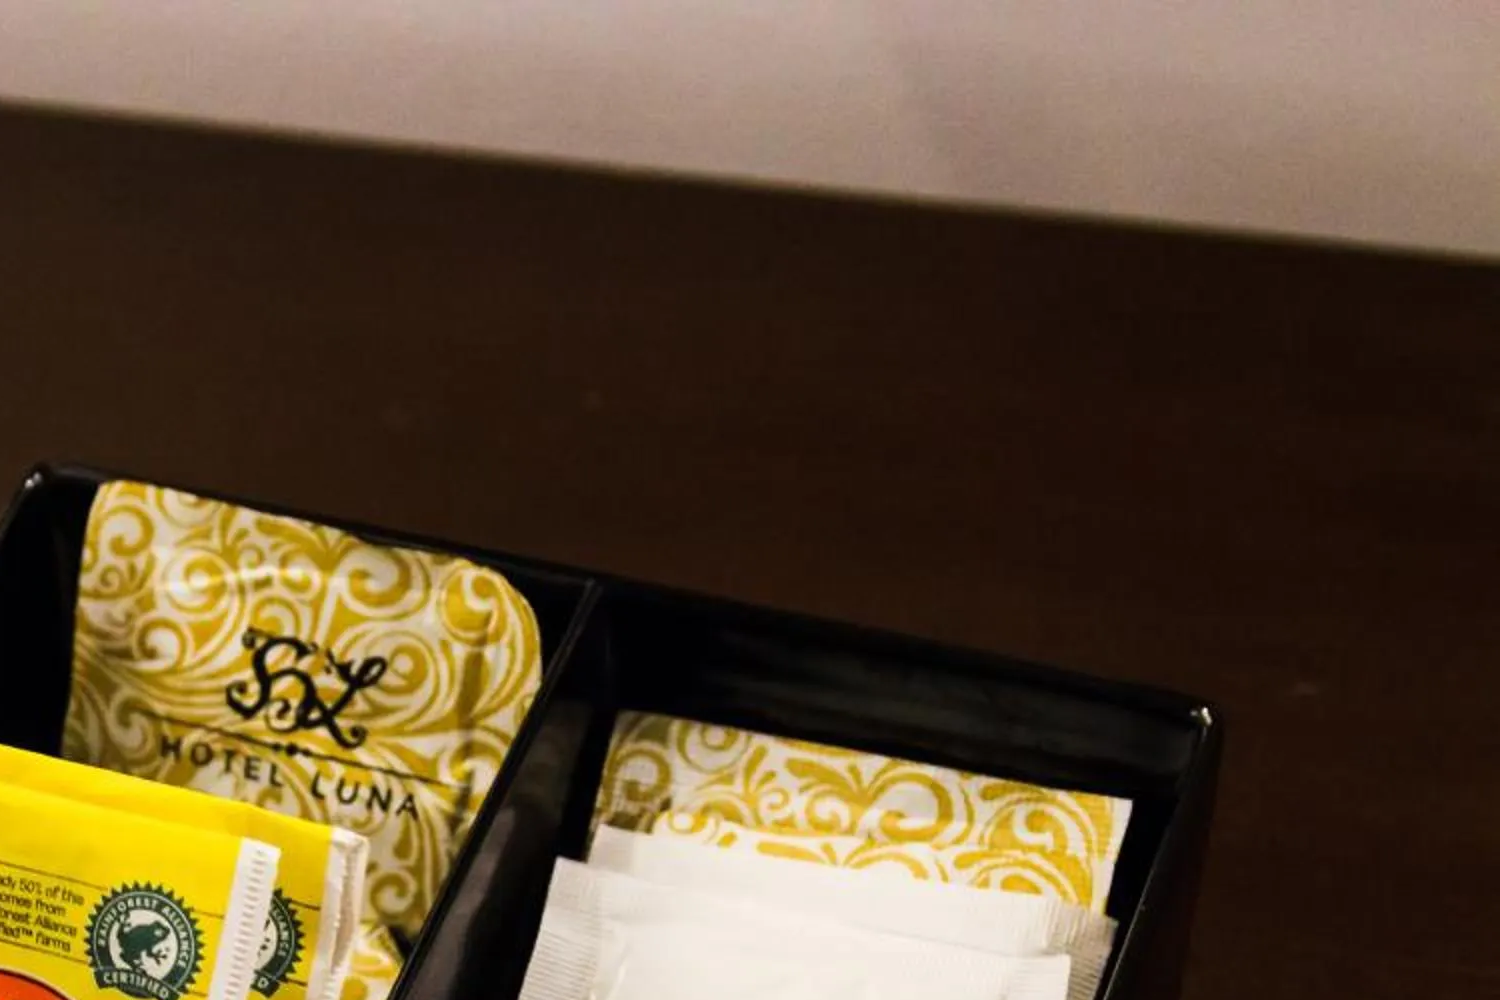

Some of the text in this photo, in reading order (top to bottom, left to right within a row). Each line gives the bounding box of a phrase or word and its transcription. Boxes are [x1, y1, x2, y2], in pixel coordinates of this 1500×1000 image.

[160, 736, 419, 821] HOTEL LUNA
[103, 972, 169, 1000] CERTIFIED
